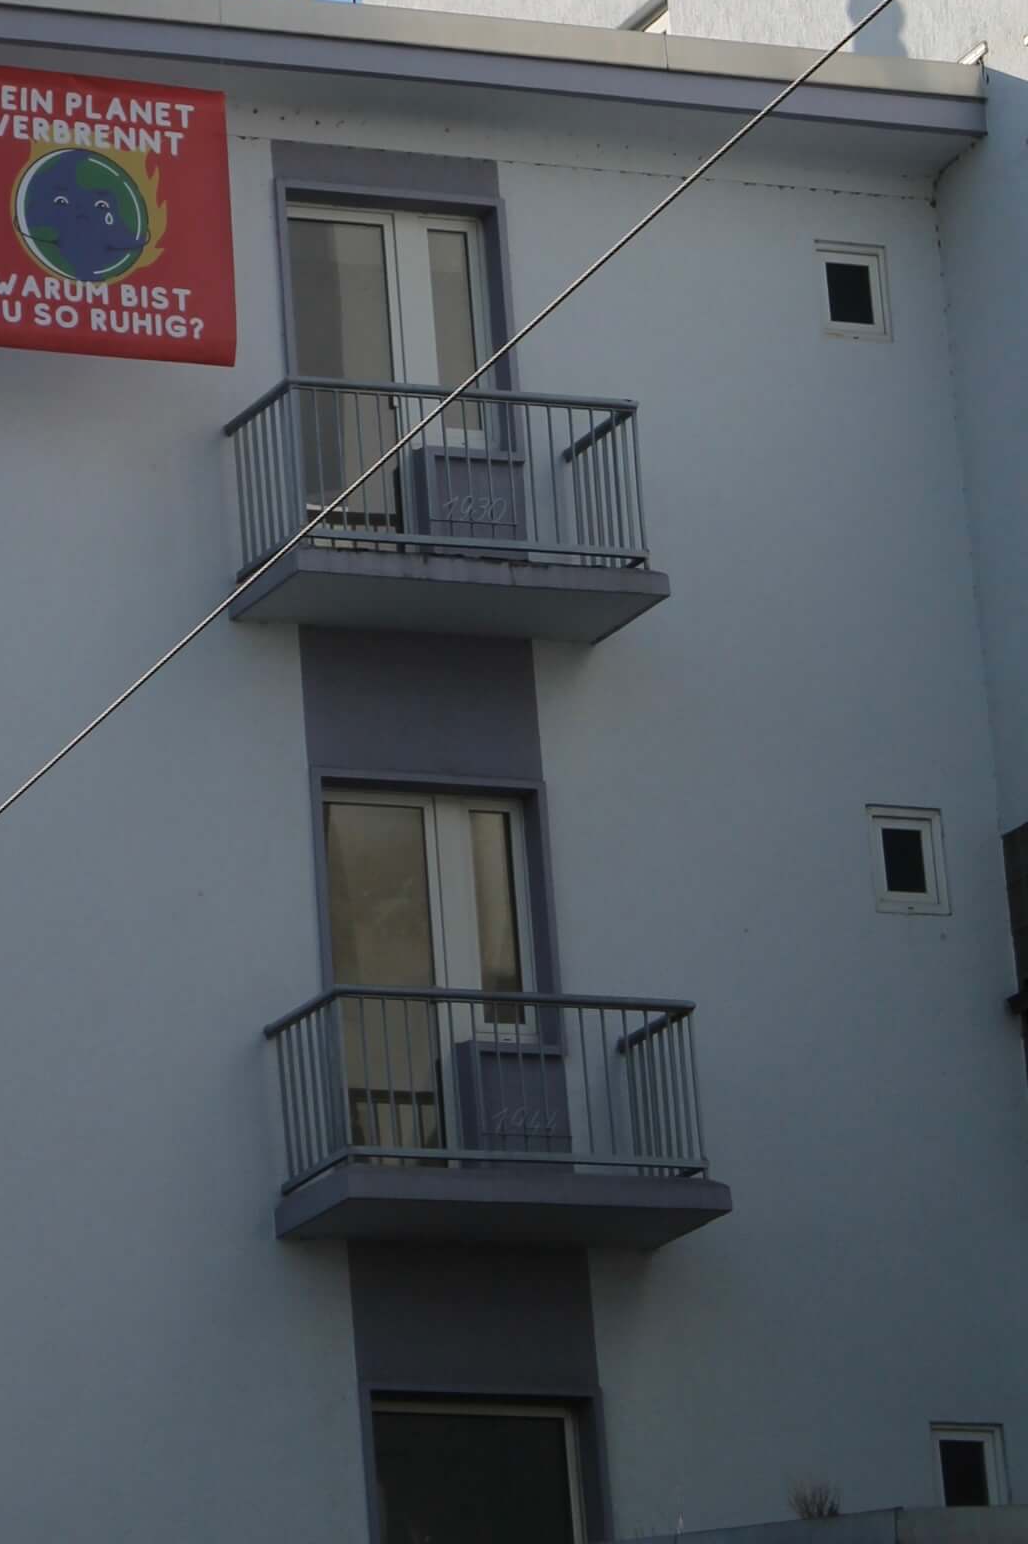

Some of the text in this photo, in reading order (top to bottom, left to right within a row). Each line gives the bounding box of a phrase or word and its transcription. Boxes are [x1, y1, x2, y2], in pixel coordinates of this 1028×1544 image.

[65, 92, 195, 129] PLANET
[121, 284, 192, 312] BIST
[34, 303, 78, 329] SO
[90, 309, 205, 340] RUHIG?
